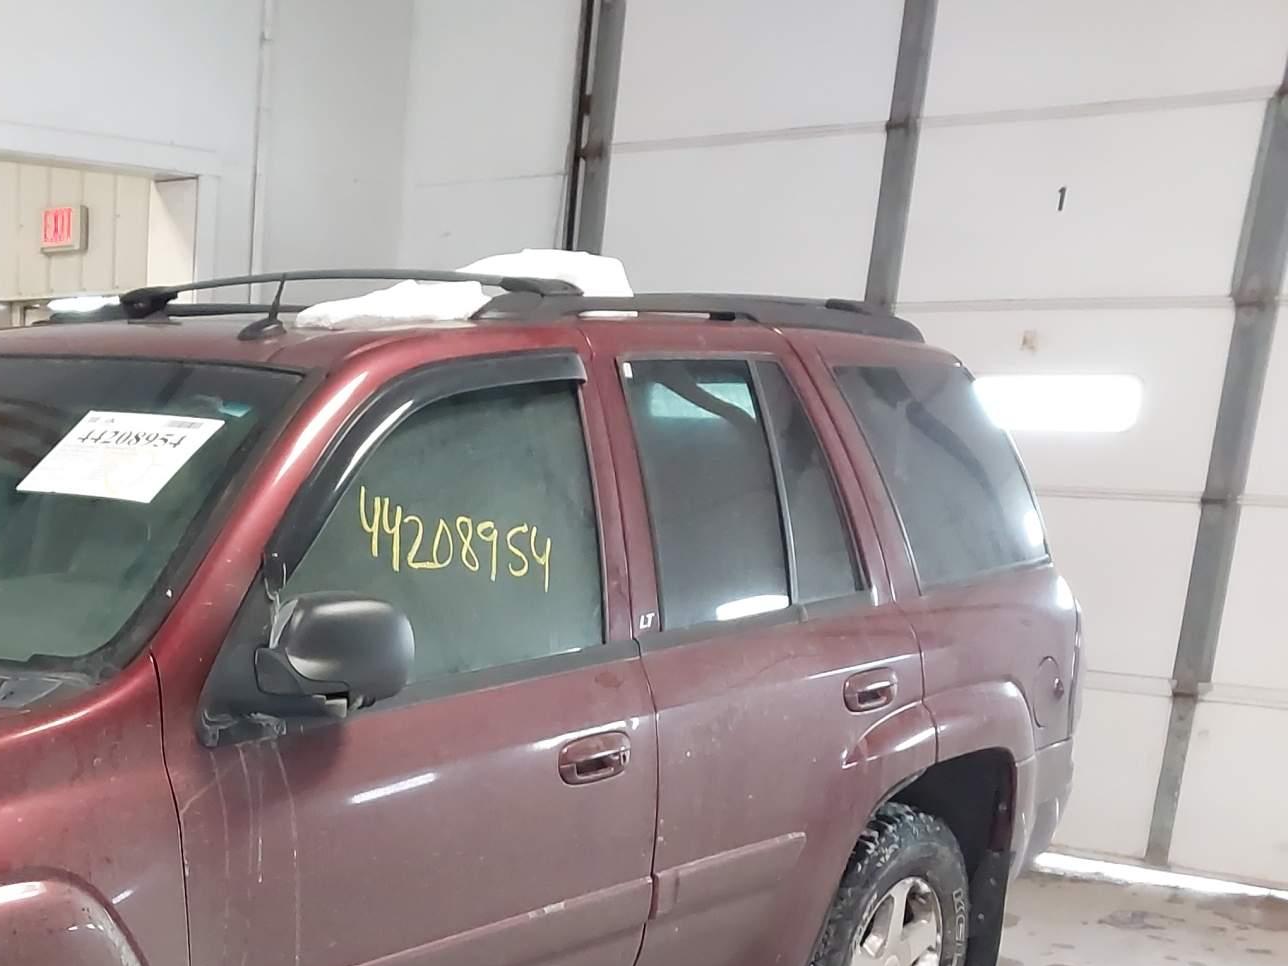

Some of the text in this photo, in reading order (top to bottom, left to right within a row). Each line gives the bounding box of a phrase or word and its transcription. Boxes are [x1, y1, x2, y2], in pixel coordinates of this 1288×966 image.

[1057, 186, 1067, 212] 1
[78, 429, 188, 449] 44208954
[360, 485, 552, 593] 44208954
[639, 612, 655, 630] LT
